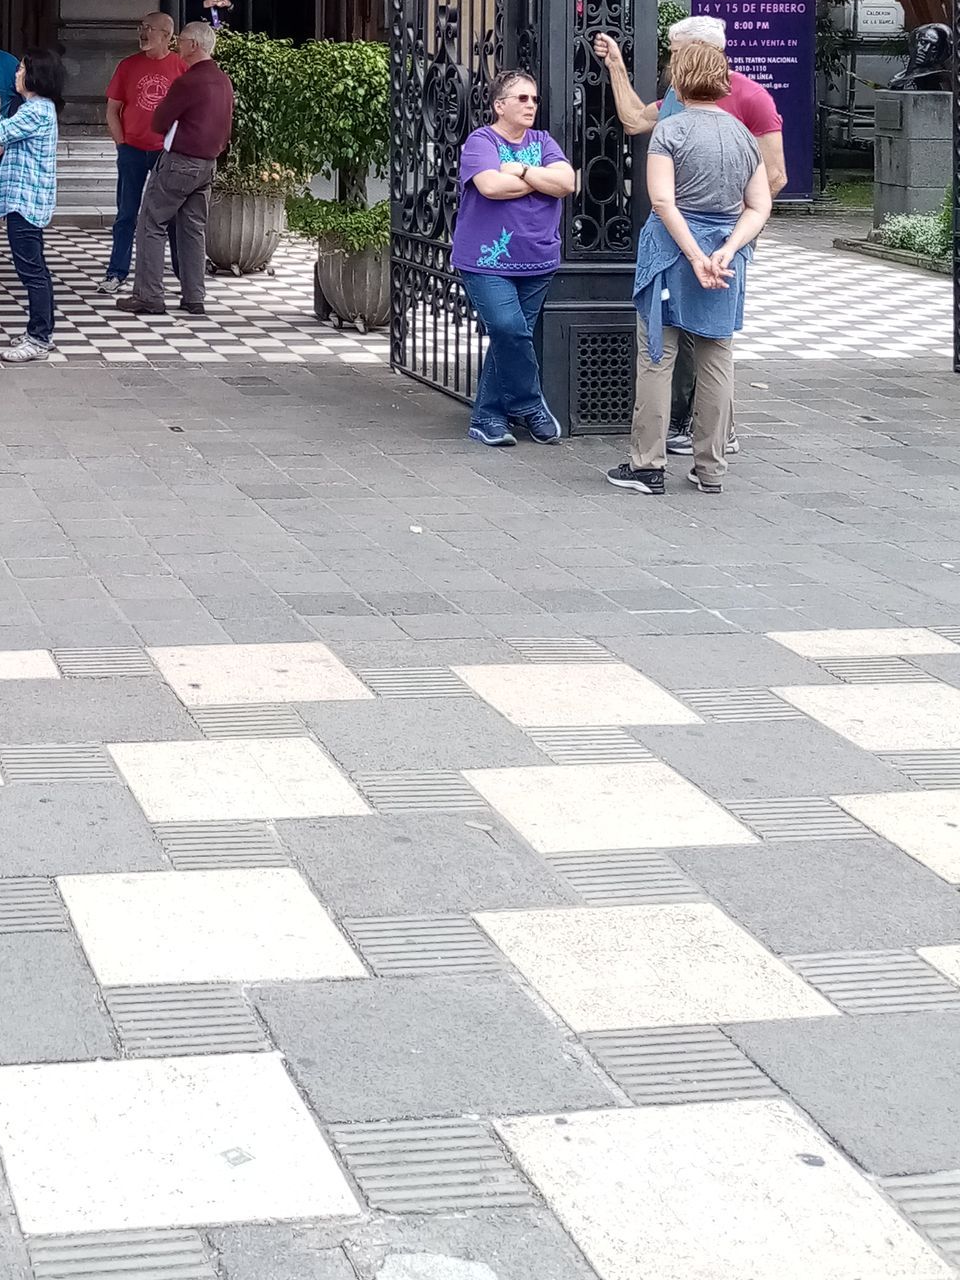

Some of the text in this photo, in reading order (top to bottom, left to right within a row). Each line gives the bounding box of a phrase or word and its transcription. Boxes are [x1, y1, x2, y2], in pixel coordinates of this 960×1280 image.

[697, 3, 806, 13] 14 Y 15 DE FEBRERO
[734, 21, 770, 30] 8:00 PM
[740, 39, 746, 47] A
[748, 39, 758, 47] LA
[760, 39, 785, 47] VENTA
[787, 39, 798, 47] EN
[767, 56, 798, 64] NACIONAL
